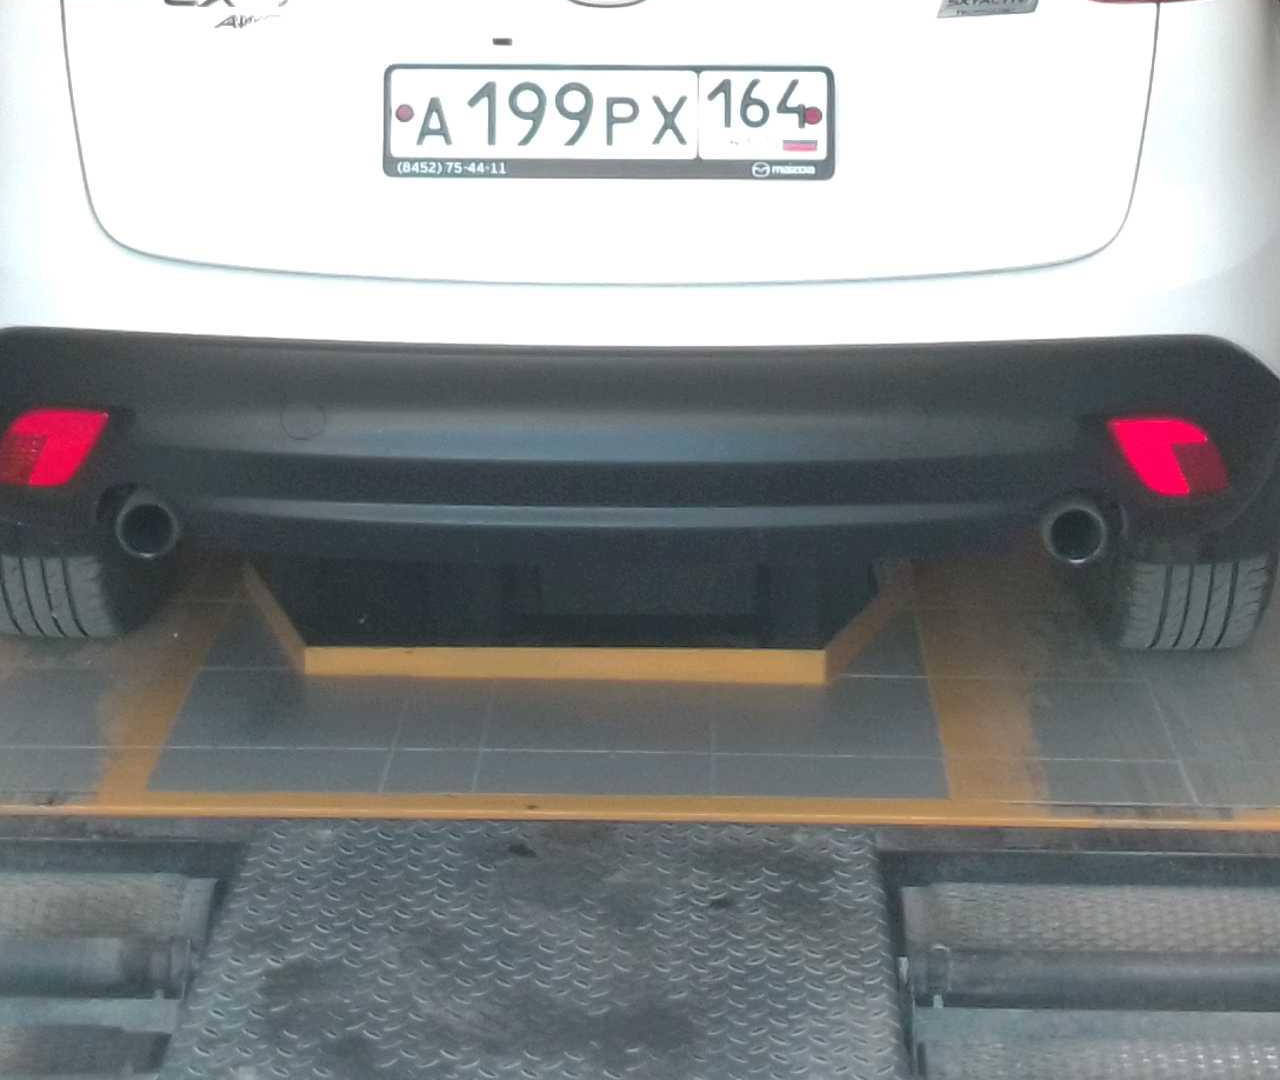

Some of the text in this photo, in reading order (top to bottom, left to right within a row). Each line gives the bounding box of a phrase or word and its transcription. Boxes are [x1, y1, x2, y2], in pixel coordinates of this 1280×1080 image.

[707, 78, 806, 129] 164
[397, 161, 507, 174] (8452) 75-44-11
